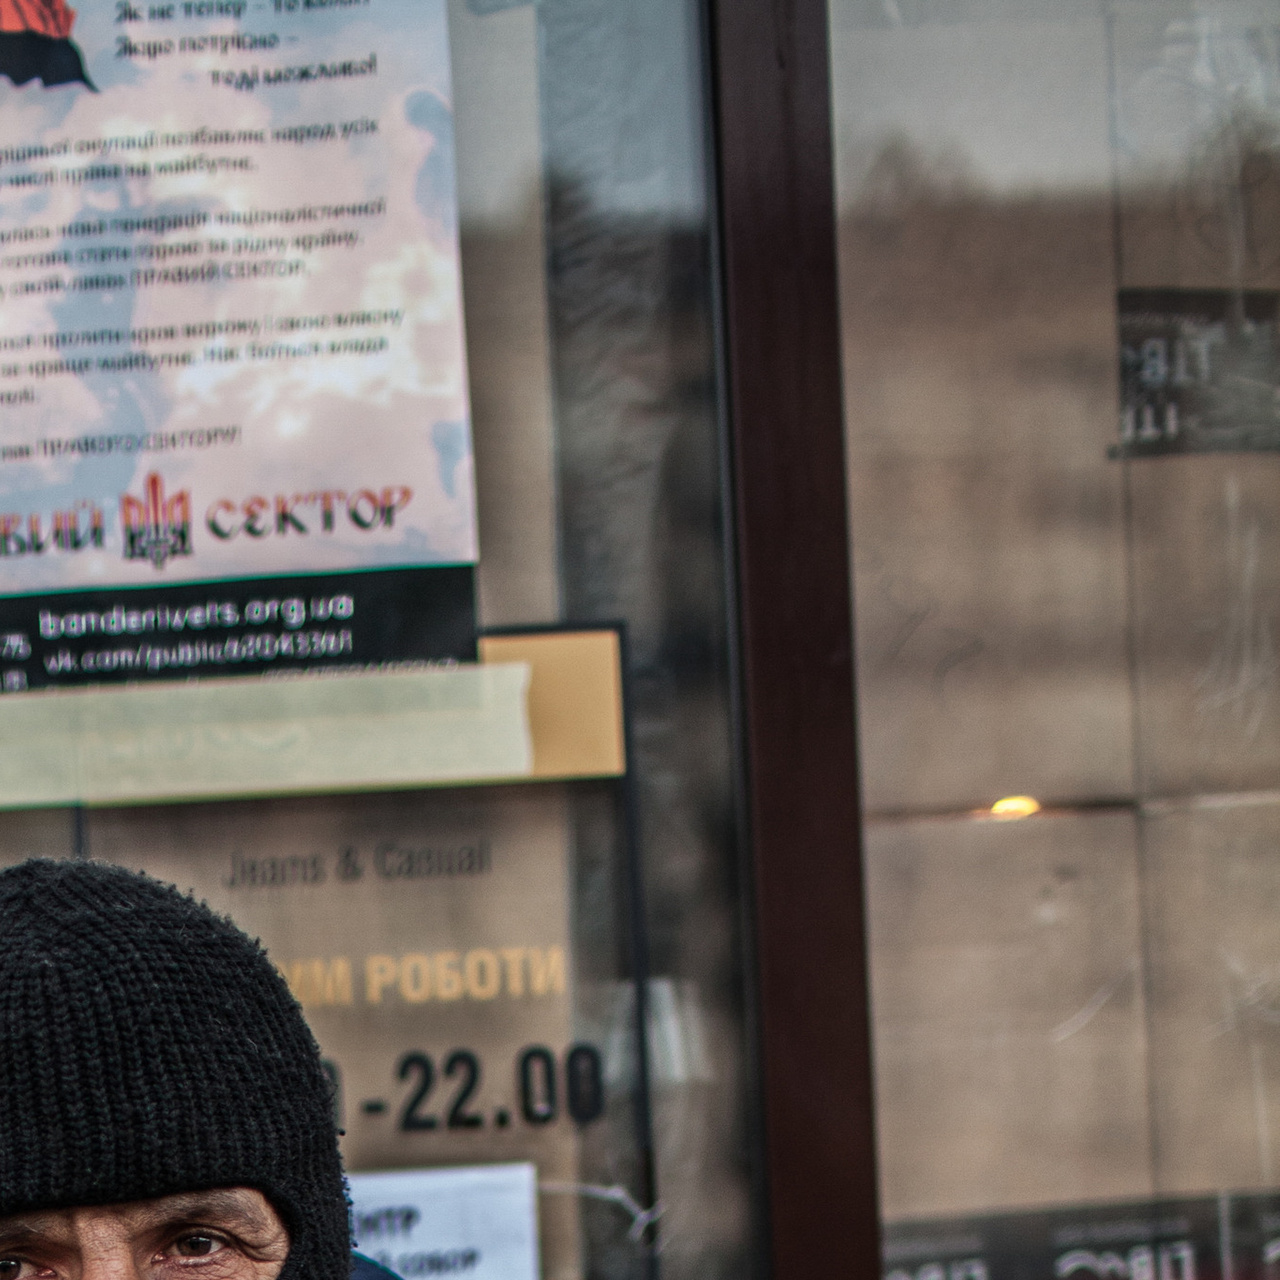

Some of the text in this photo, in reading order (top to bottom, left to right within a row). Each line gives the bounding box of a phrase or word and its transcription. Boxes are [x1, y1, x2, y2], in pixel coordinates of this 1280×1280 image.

[273, 123, 336, 146] народ
[132, 260, 219, 288] ПРАВИЙ
[40, 329, 125, 351] пролити
[39, 433, 139, 459] ПРАВОГО
[206, 484, 415, 540] СЕКТОР
[365, 946, 566, 1003] РОБОТИ
